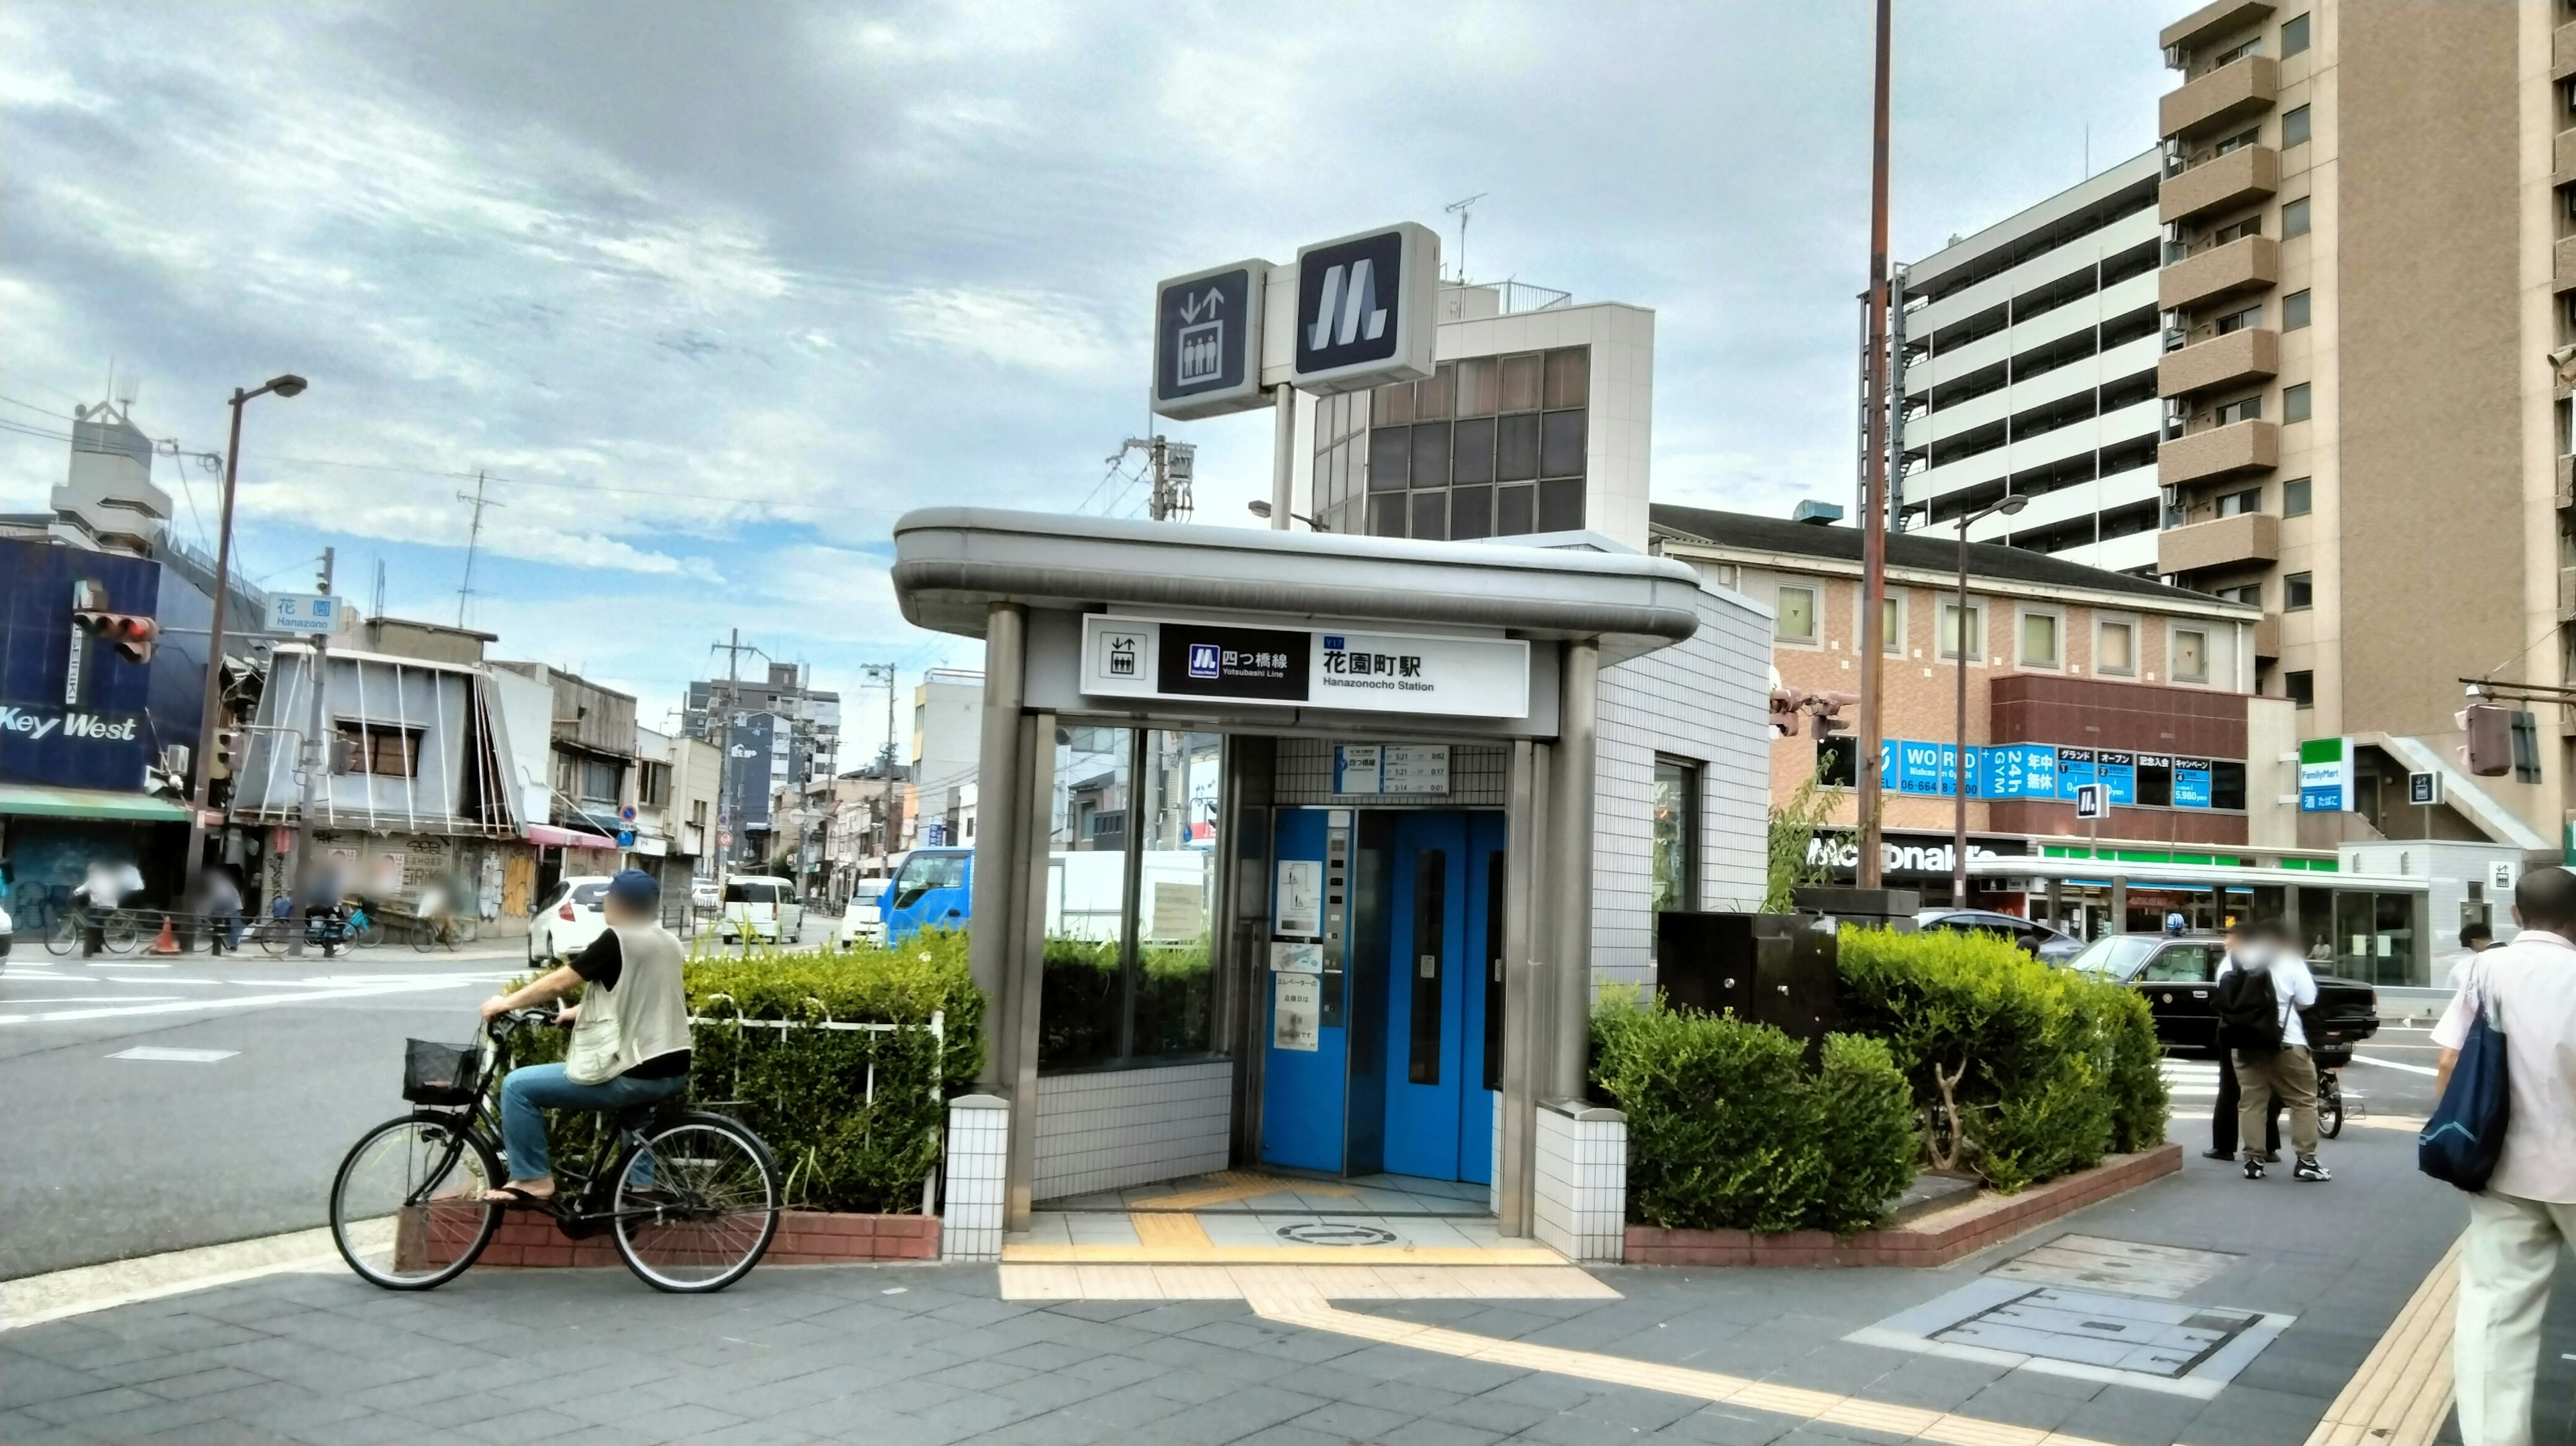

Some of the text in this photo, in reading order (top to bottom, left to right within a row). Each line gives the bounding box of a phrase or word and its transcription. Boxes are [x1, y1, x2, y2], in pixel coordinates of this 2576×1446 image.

[277, 617, 328, 628] Hanazono
[1326, 639, 1342, 648] Y17
[1222, 651, 1287, 669] 四つ橋線
[1323, 651, 1421, 678] 花園町駅
[1223, 668, 1265, 677] Yotsubashi
[1323, 676, 1434, 691] Hanazonocho Station
[0, 706, 137, 741] Key West
[1907, 748, 1976, 769] WORD
[2027, 753, 2053, 771] 年中
[2061, 750, 2208, 769] グランド オープン 記念入会 キャンペーン
[1994, 751, 2006, 793] GYM
[2008, 750, 2022, 793] 24h
[2302, 769, 2339, 780] FamilyMart
[1901, 780, 1978, 794] 06-6648-700
[2027, 772, 2053, 791] 無休
[2318, 795, 2338, 806] たばこ
[1277, 978, 1317, 987] エレベーターの
[1284, 994, 1309, 1003] 点検日は
